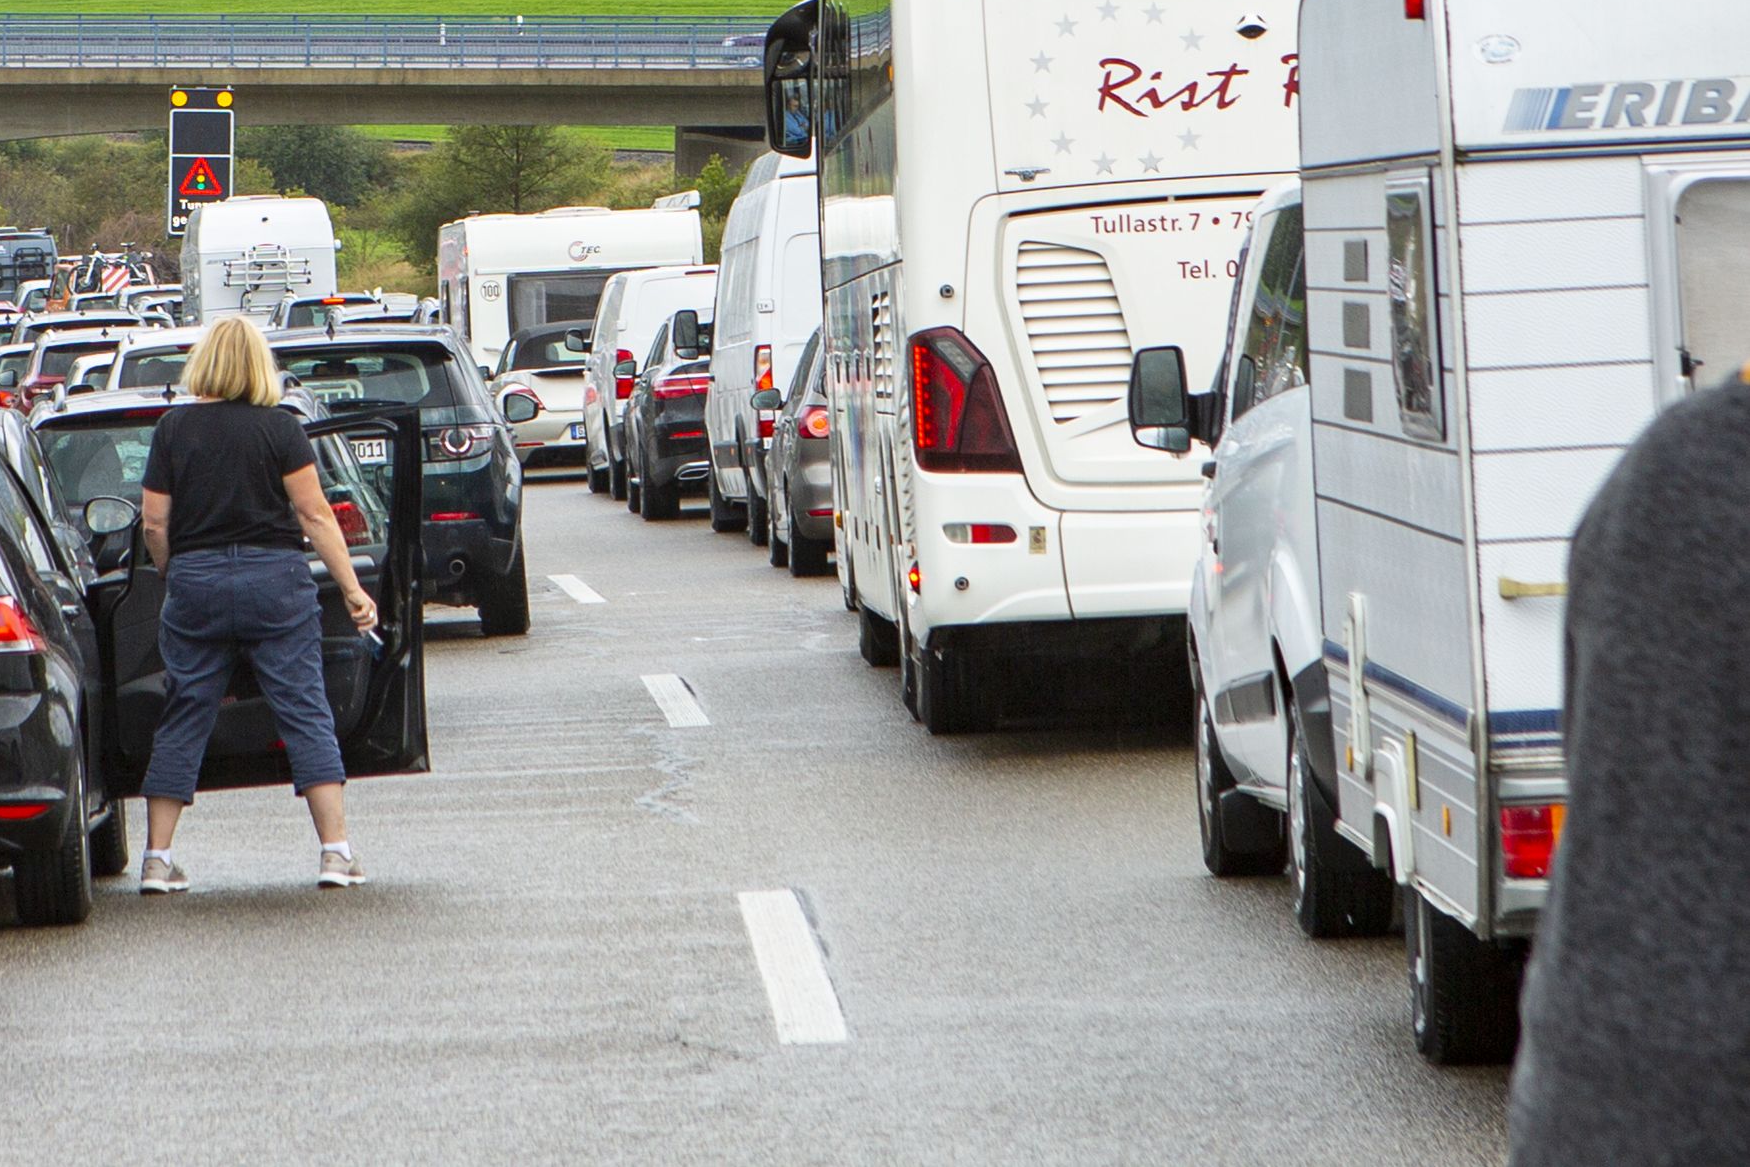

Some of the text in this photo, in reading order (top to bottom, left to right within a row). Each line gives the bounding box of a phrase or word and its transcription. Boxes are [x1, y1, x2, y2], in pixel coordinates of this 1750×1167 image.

[1097, 57, 1249, 118] Rist
[1557, 78, 1750, 130] ERIB
[1091, 213, 1183, 234] Tullastr.
[1189, 213, 1200, 231] 7
[1177, 259, 1217, 280] Tel.
[482, 285, 500, 297] 100
